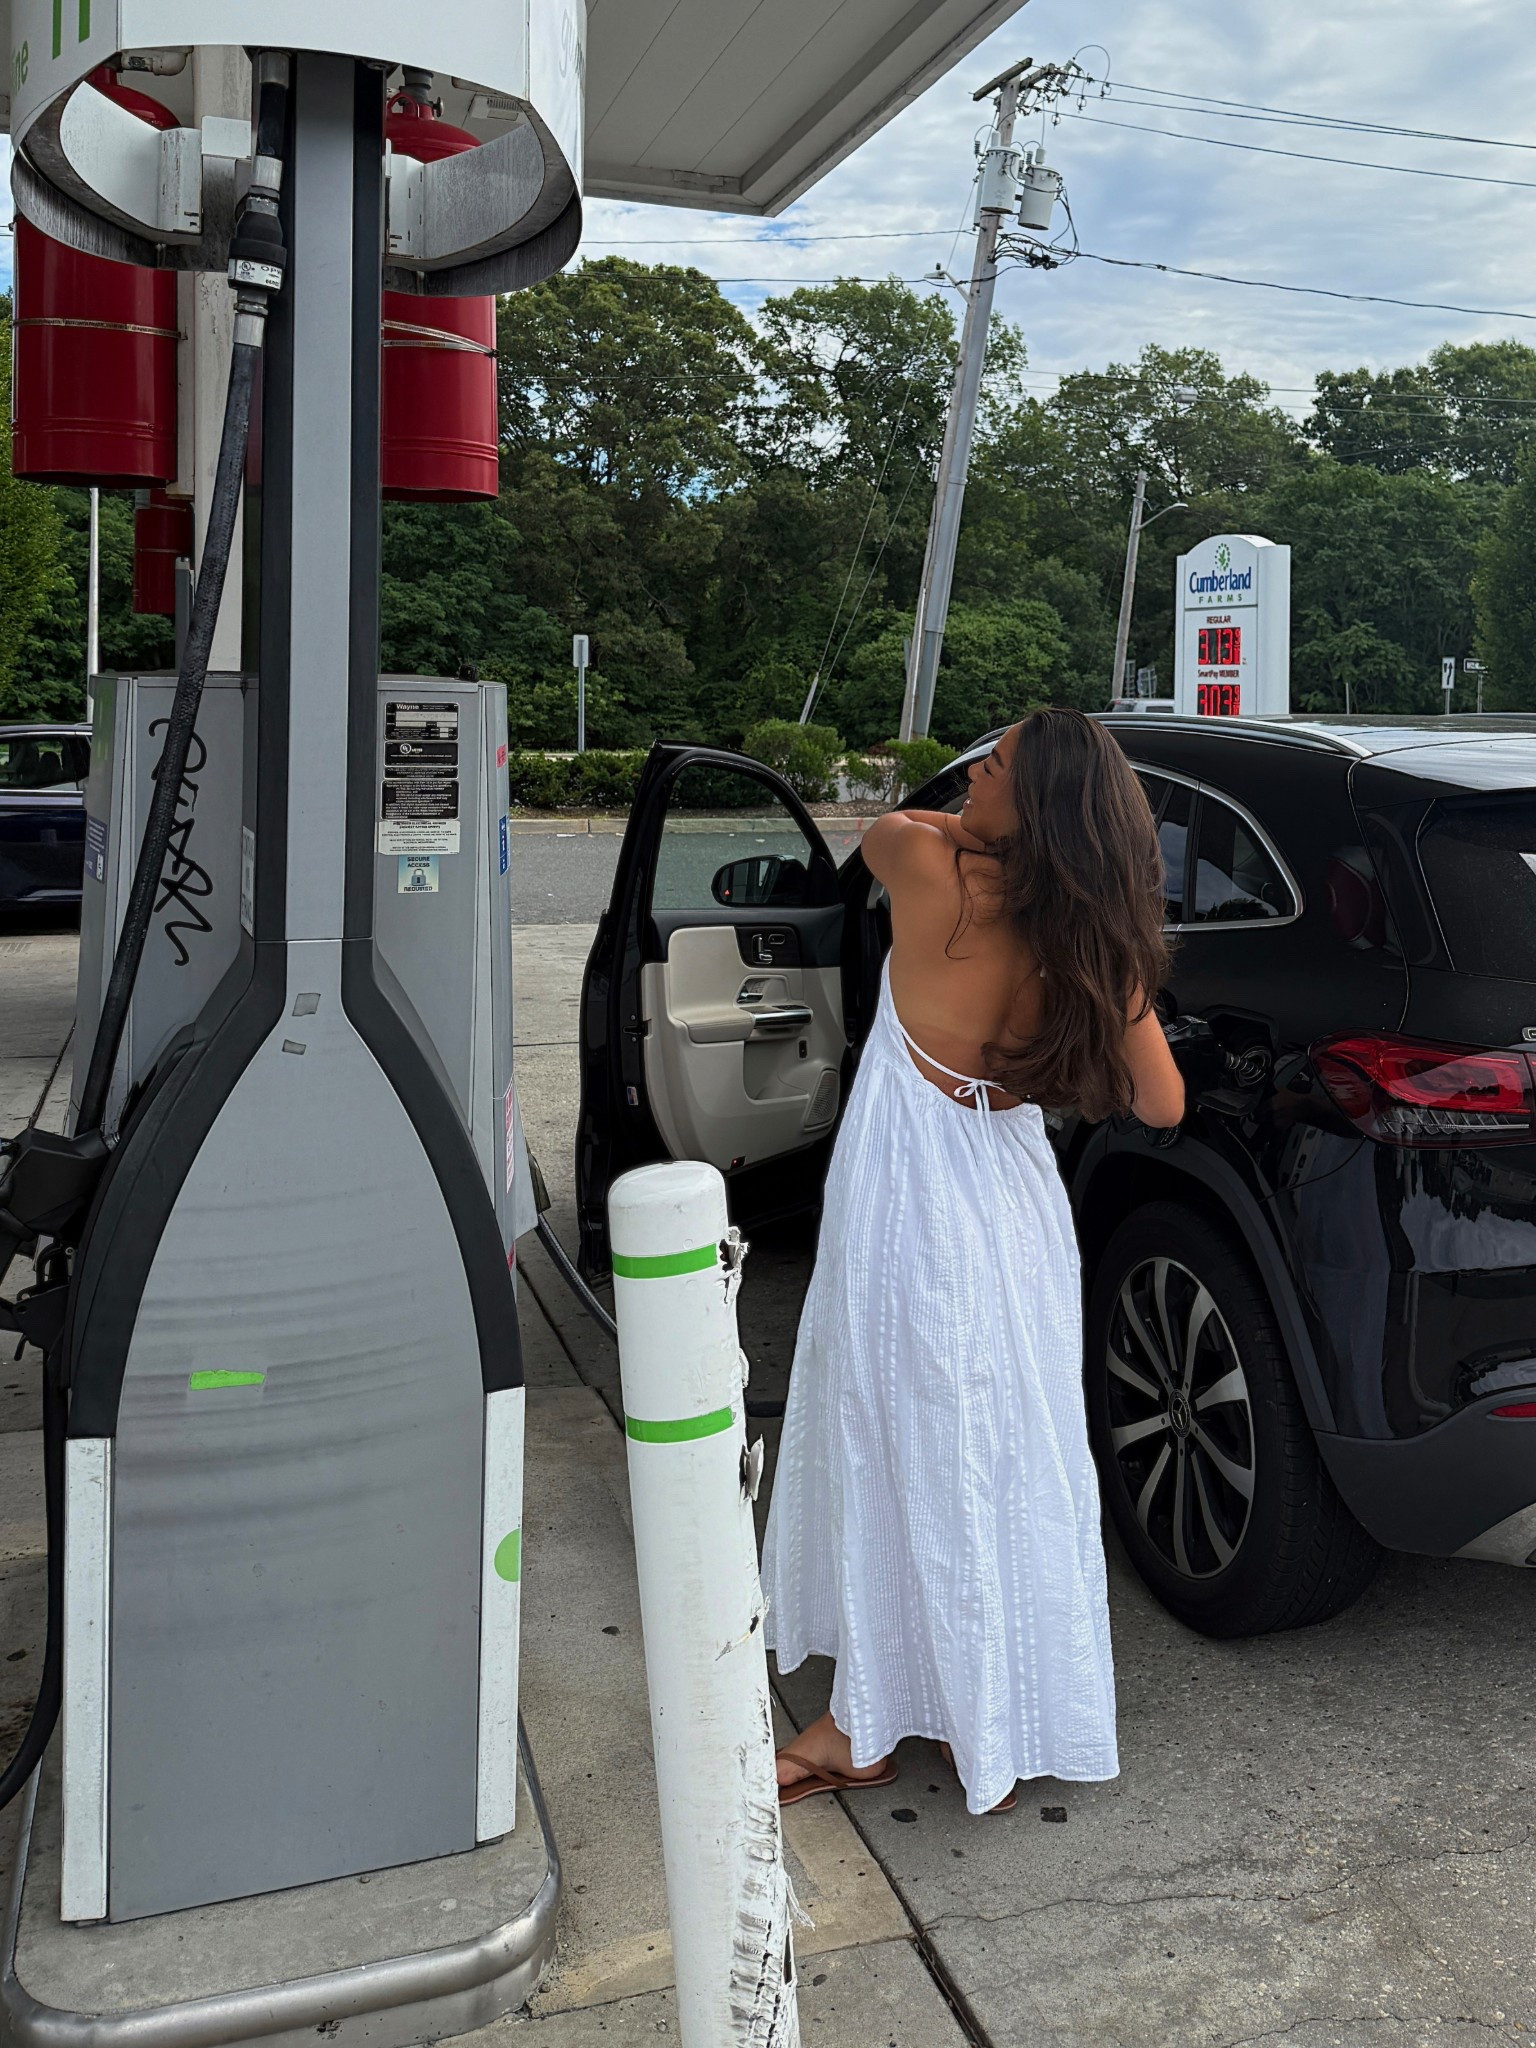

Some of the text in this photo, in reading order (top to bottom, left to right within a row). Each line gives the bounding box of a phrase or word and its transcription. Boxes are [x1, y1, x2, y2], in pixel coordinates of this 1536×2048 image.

[1189, 566, 1251, 593] Cumberland
[1199, 594, 1242, 604] FARMS
[1207, 615, 1231, 623] REGULAR
